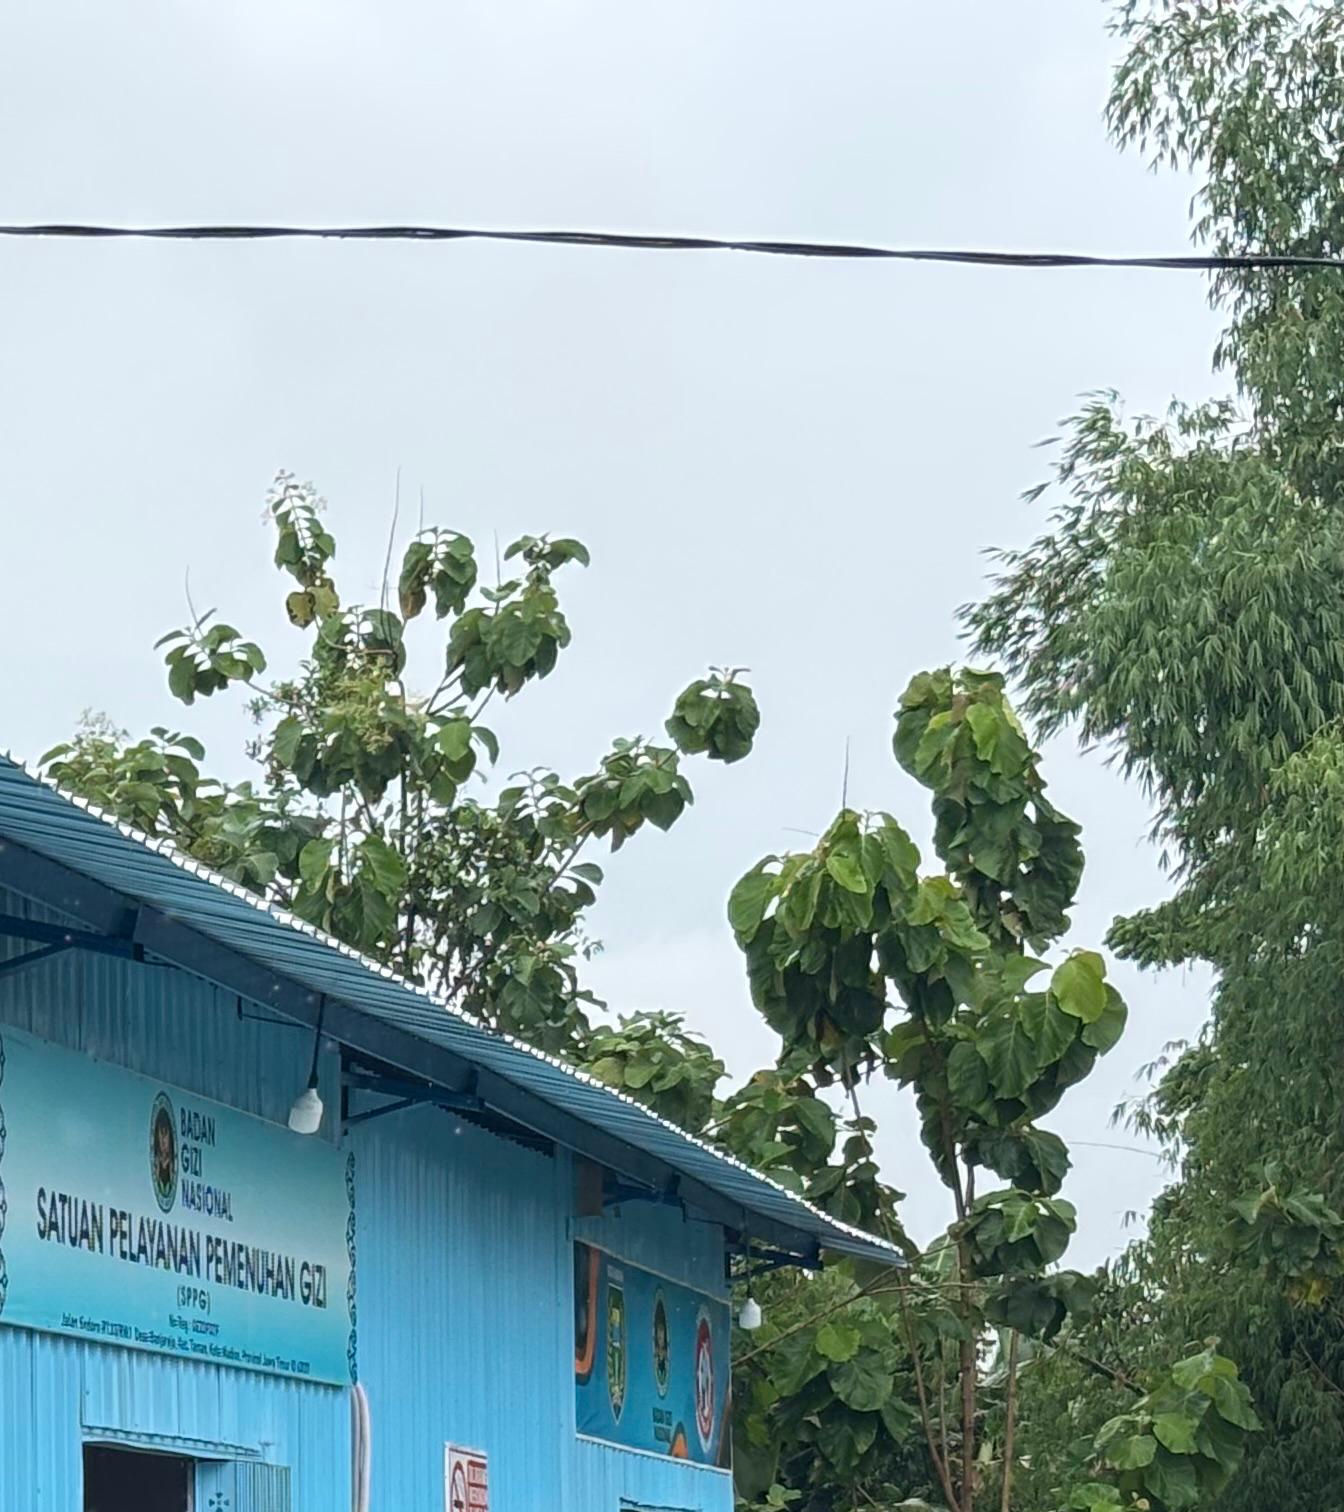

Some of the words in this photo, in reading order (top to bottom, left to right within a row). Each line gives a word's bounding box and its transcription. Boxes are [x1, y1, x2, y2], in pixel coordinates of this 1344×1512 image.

[180, 1107, 216, 1147] BADAN
[181, 1143, 202, 1177] GIZI
[181, 1179, 234, 1222] NASIONAL
[37, 1187, 104, 1254] SATUAN
[109, 1207, 201, 1279] PELAYANAN
[206, 1234, 296, 1302] PEMENUHAN
[300, 1260, 328, 1309] GIZI
[177, 1285, 212, 1315] (SPPG)
